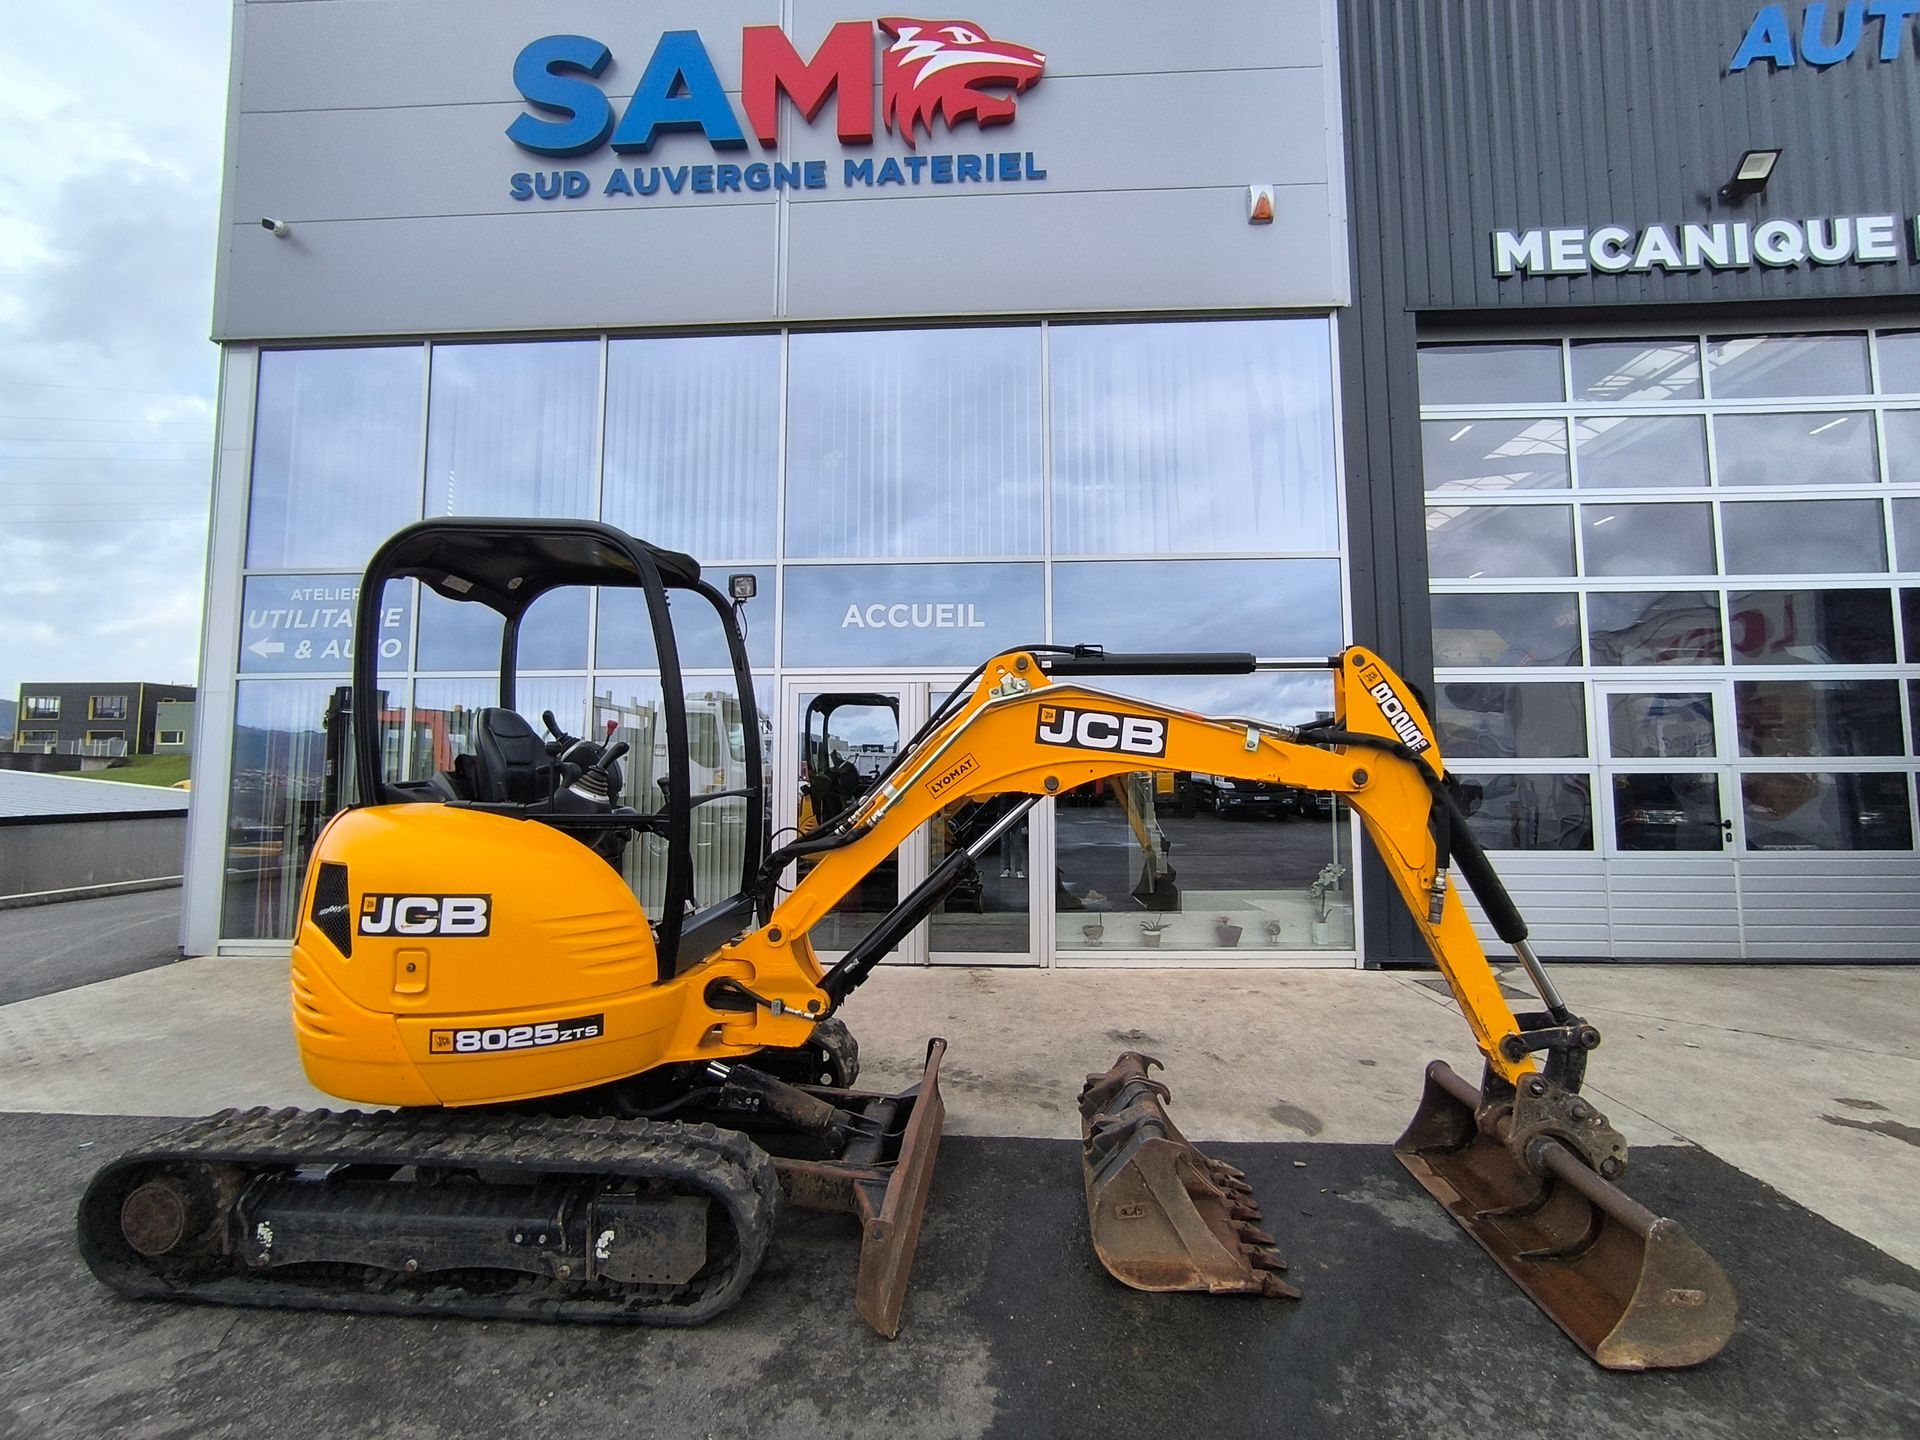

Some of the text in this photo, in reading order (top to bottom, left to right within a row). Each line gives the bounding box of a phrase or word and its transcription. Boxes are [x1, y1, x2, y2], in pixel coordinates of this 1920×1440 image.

[505, 21, 873, 158] SAM
[509, 151, 1048, 201] SUD AUVERGNE MATERIEL
[1495, 215, 1898, 273] MECANIQUE
[248, 607, 404, 630] UTILITAE
[841, 603, 986, 629] ACCUEIL
[294, 638, 402, 660] & AUO
[1039, 709, 1164, 754] JCB
[931, 759, 973, 793] LYOMAT
[361, 896, 488, 935] JCB
